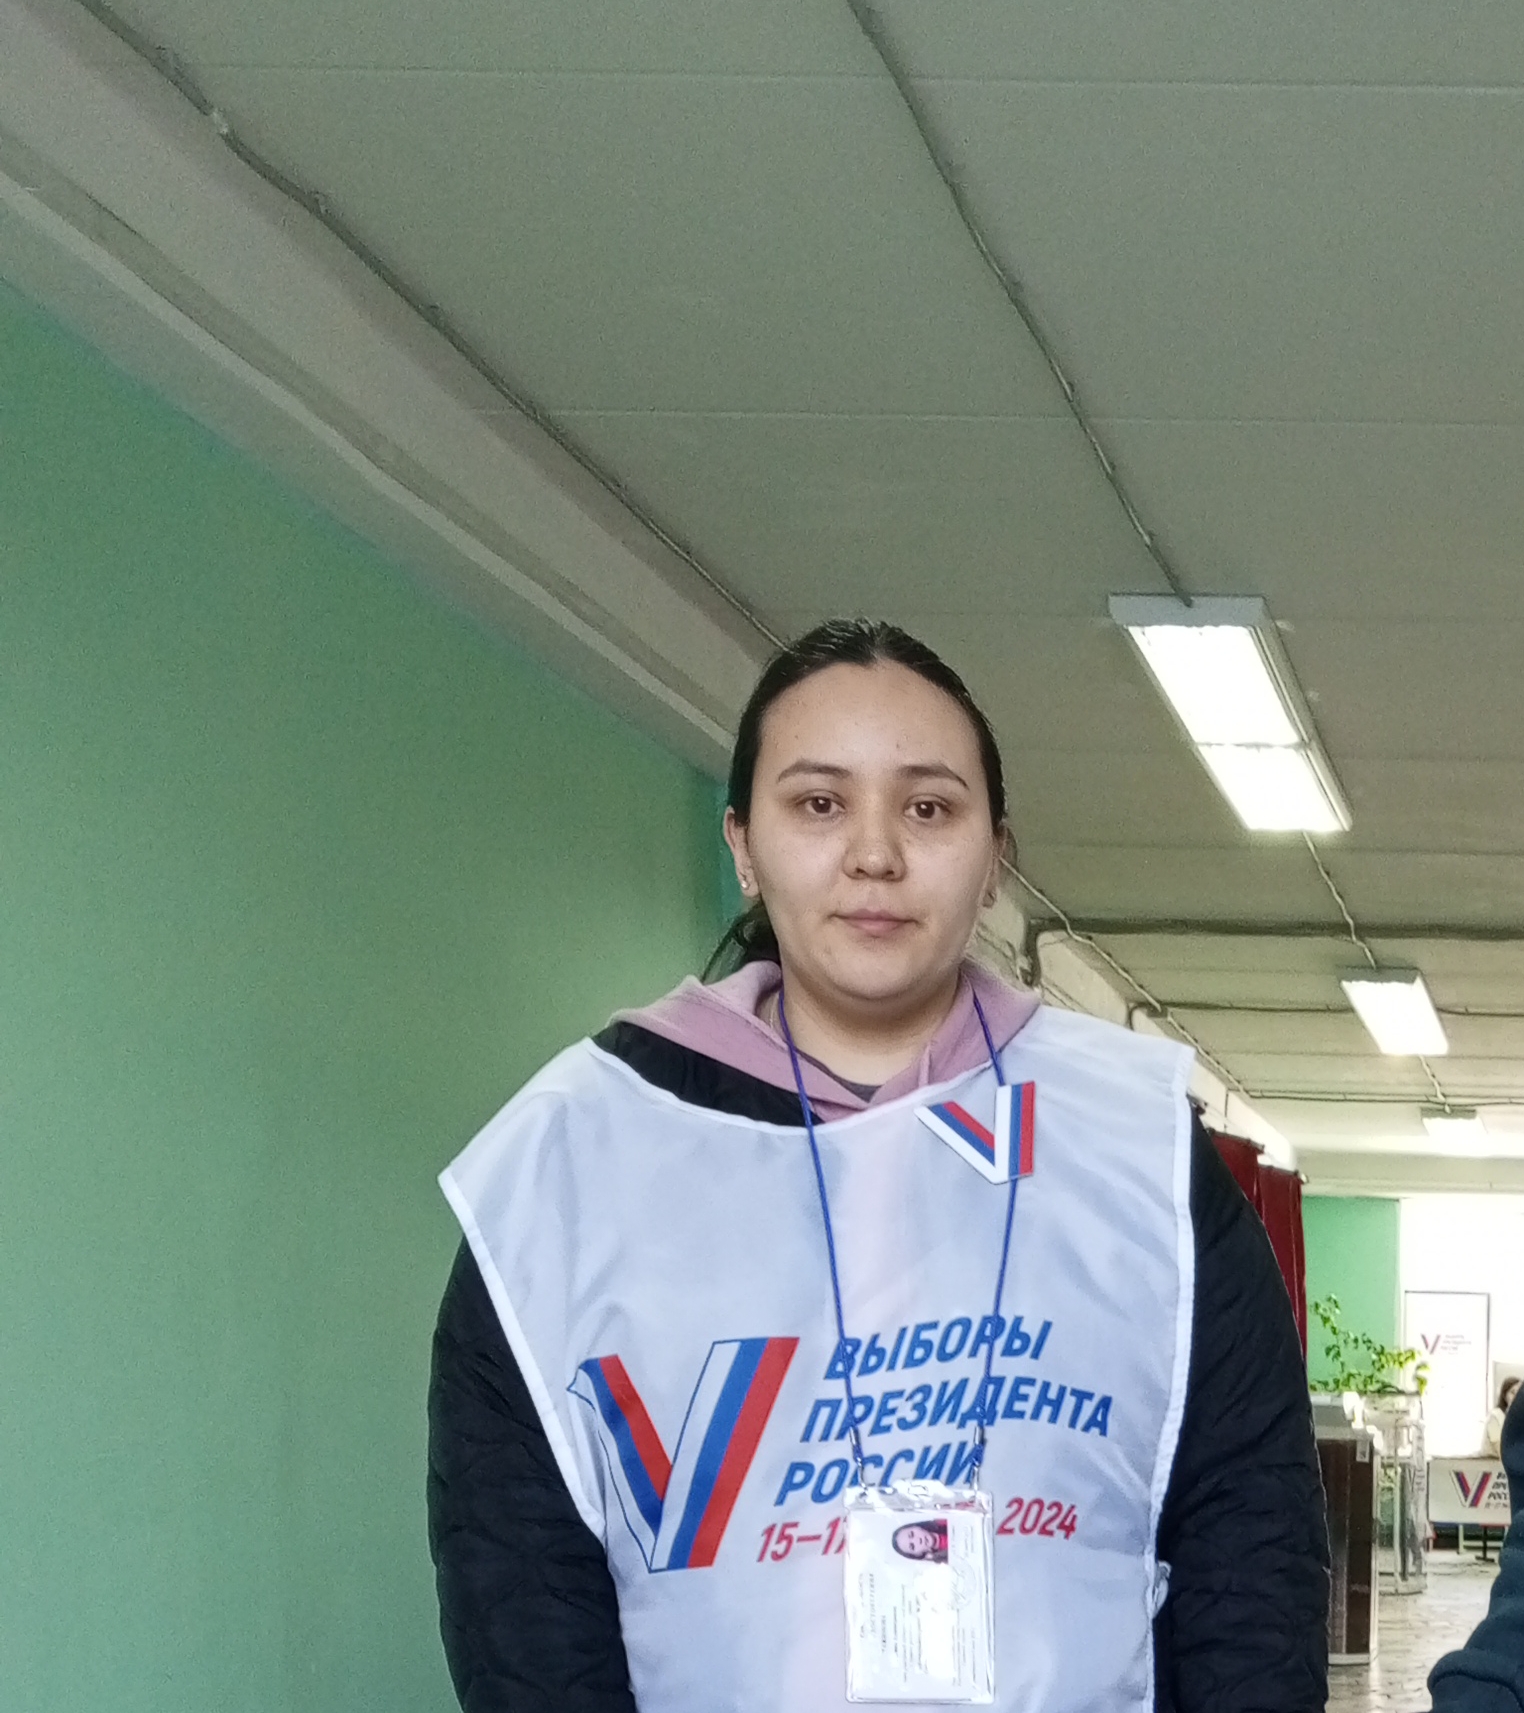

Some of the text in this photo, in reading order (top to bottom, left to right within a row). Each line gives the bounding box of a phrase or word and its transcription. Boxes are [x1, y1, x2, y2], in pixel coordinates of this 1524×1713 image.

[823, 1314, 1053, 1381] ВЫБОРЫ
[799, 1375, 1114, 1443] ПРЕЗИДЕНТА
[773, 1440, 978, 1507] РОССИИ
[995, 1496, 1079, 1541] 2024
